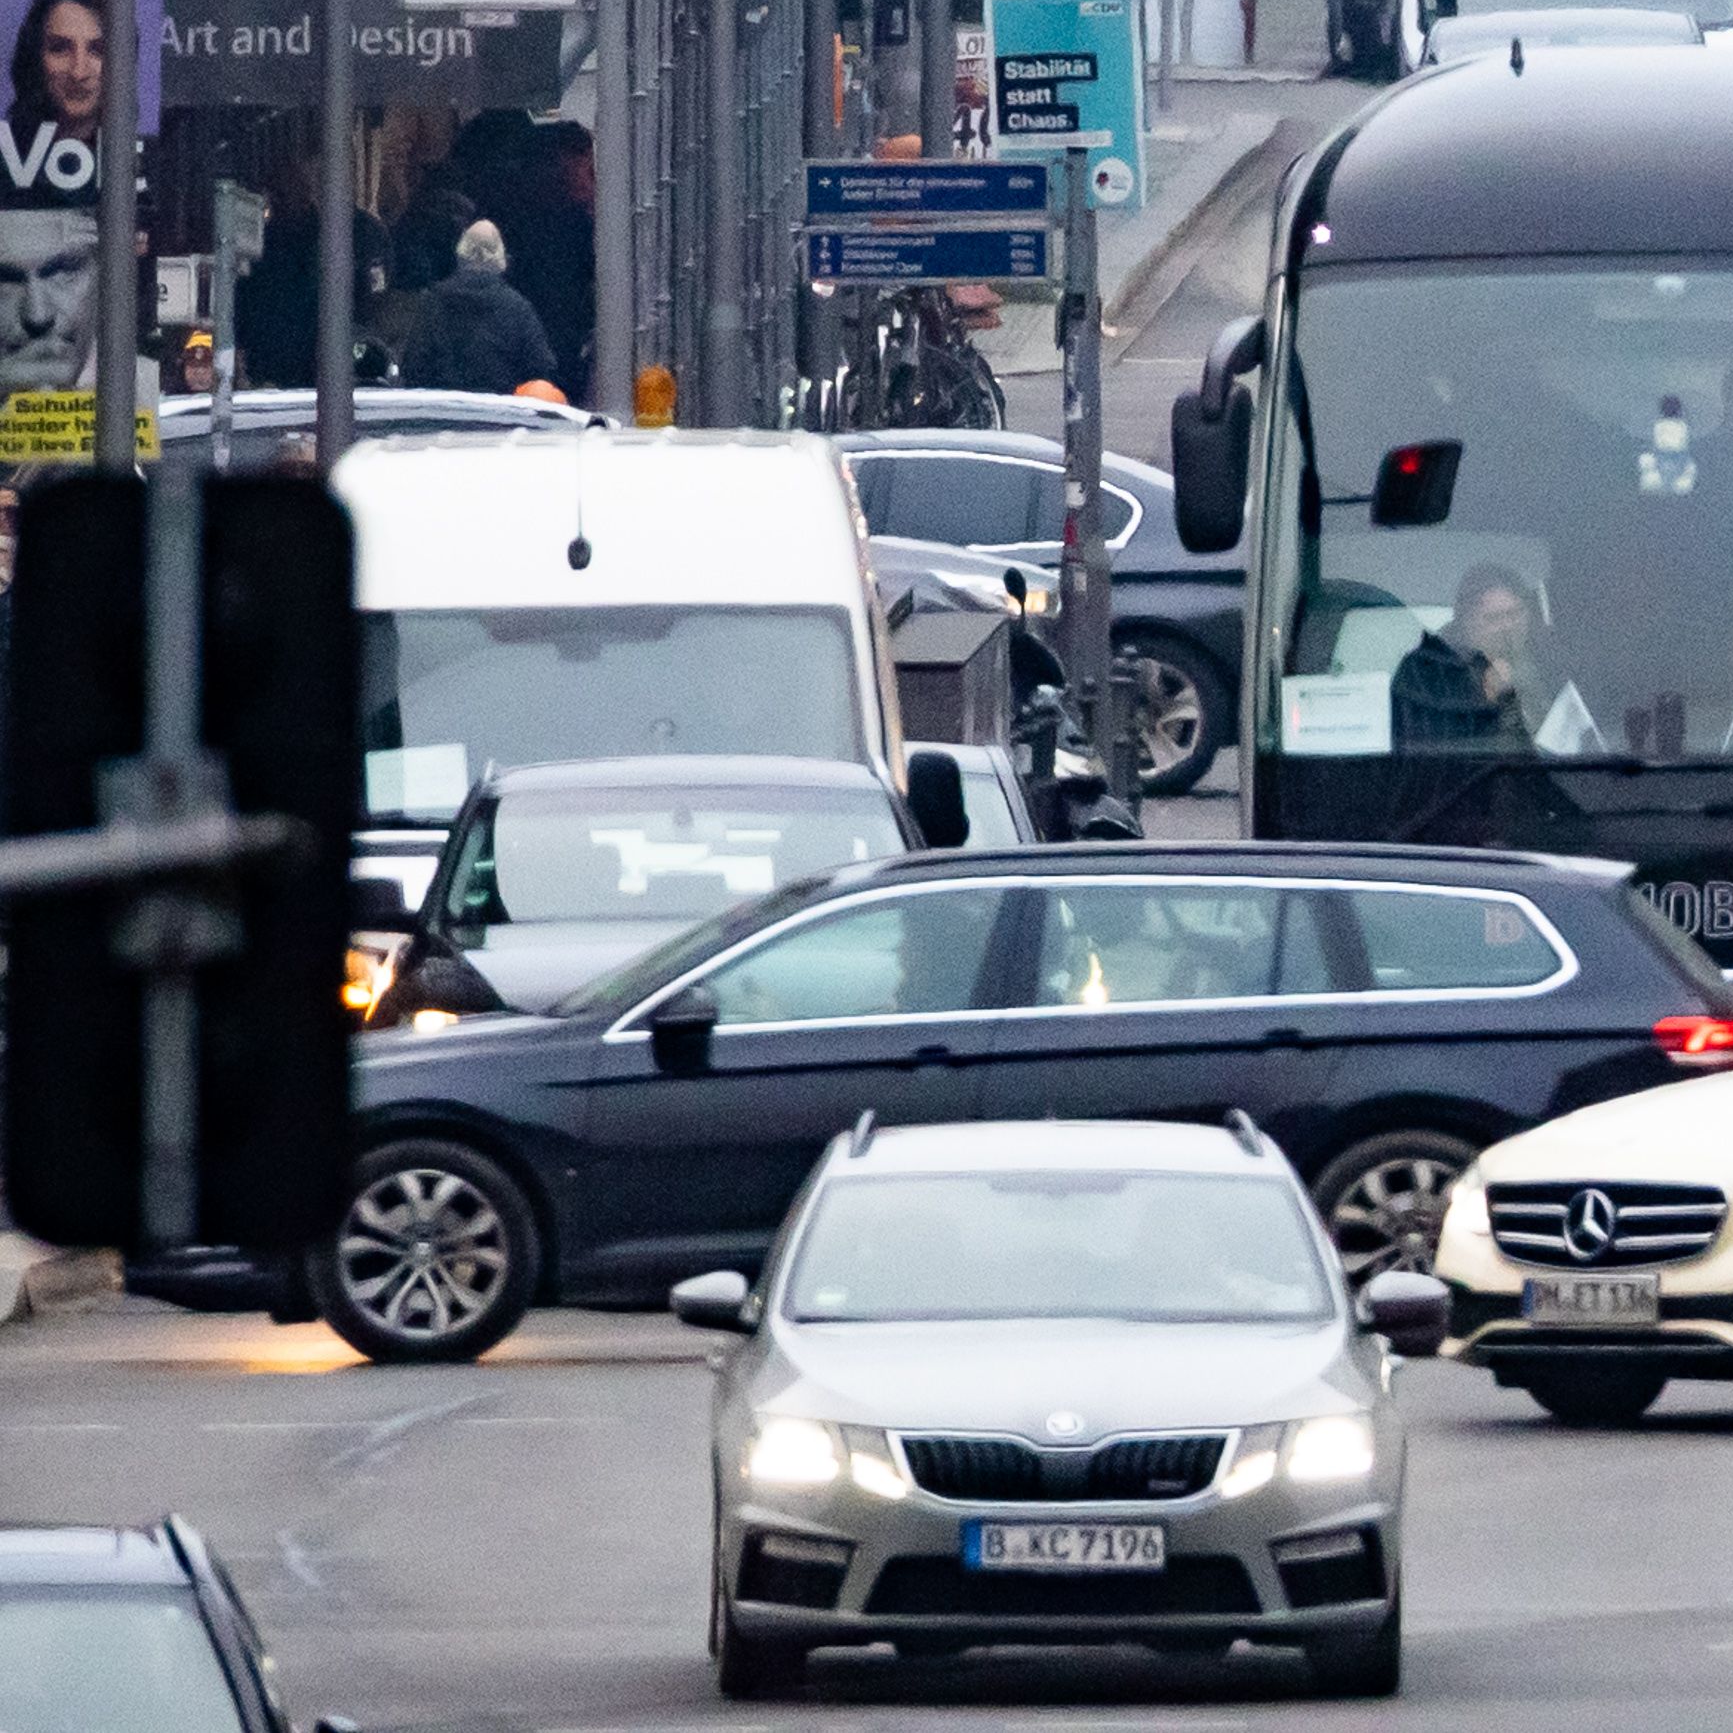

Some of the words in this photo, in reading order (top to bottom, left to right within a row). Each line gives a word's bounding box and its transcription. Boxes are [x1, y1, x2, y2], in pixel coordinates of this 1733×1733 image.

[231, 15, 311, 56] and
[350, 15, 474, 66] esign
[1004, 58, 1092, 80] Stabilität
[1006, 88, 1052, 105] statt
[1007, 113, 1074, 130] Chaos.
[986, 1528, 1005, 1559] B
[1029, 1527, 1070, 1559] KC
[1079, 1528, 1158, 1561] 7196
